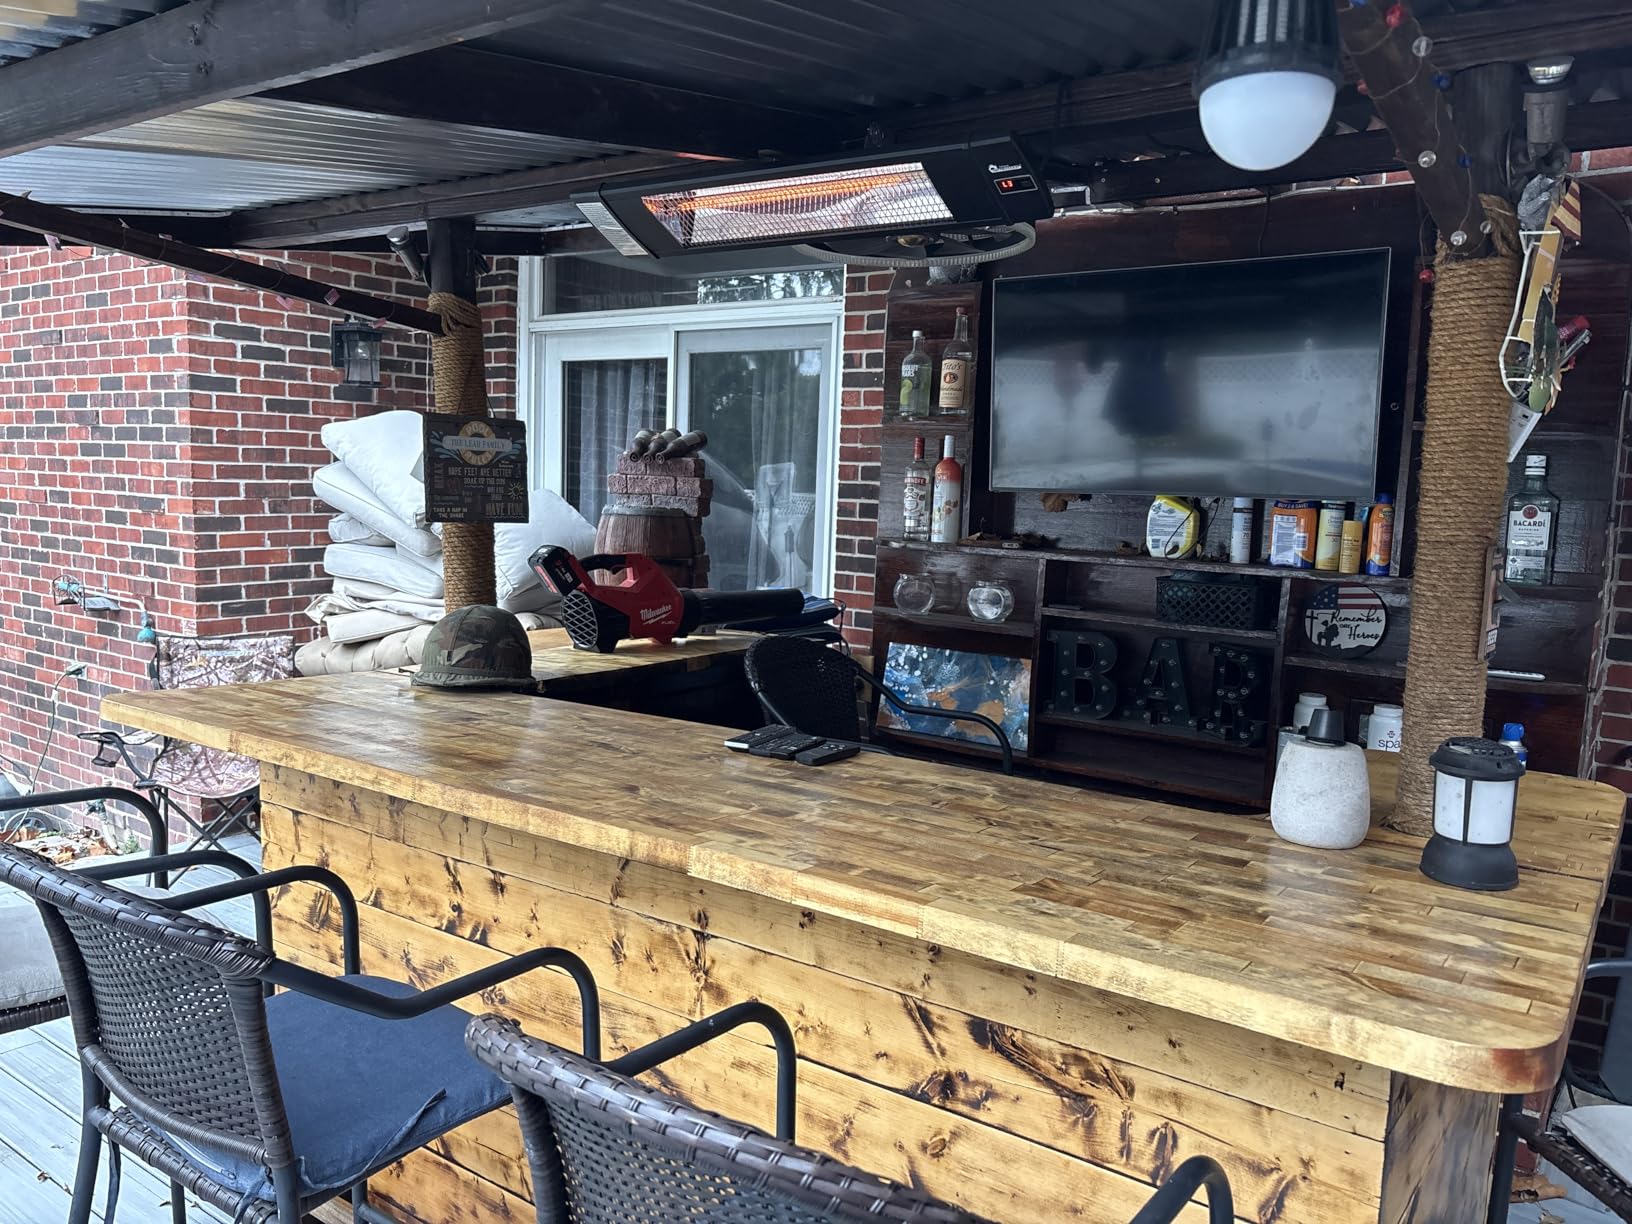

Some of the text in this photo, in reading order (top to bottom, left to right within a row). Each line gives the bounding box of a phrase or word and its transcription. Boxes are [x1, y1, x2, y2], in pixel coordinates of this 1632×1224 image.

[943, 362, 963, 371] Tito's
[465, 423, 489, 435] POOL
[451, 439, 463, 448] THE
[482, 440, 505, 450] FAMILY
[464, 467, 478, 476] FEET
[480, 467, 490, 476] ARE
[493, 468, 512, 477] BETTER
[640, 603, 672, 621] Milwaukee
[1331, 604, 1382, 623] Remember
[1348, 624, 1380, 640] Heroes
[1047, 630, 1257, 747] BAR
[1378, 739, 1401, 752] spa
